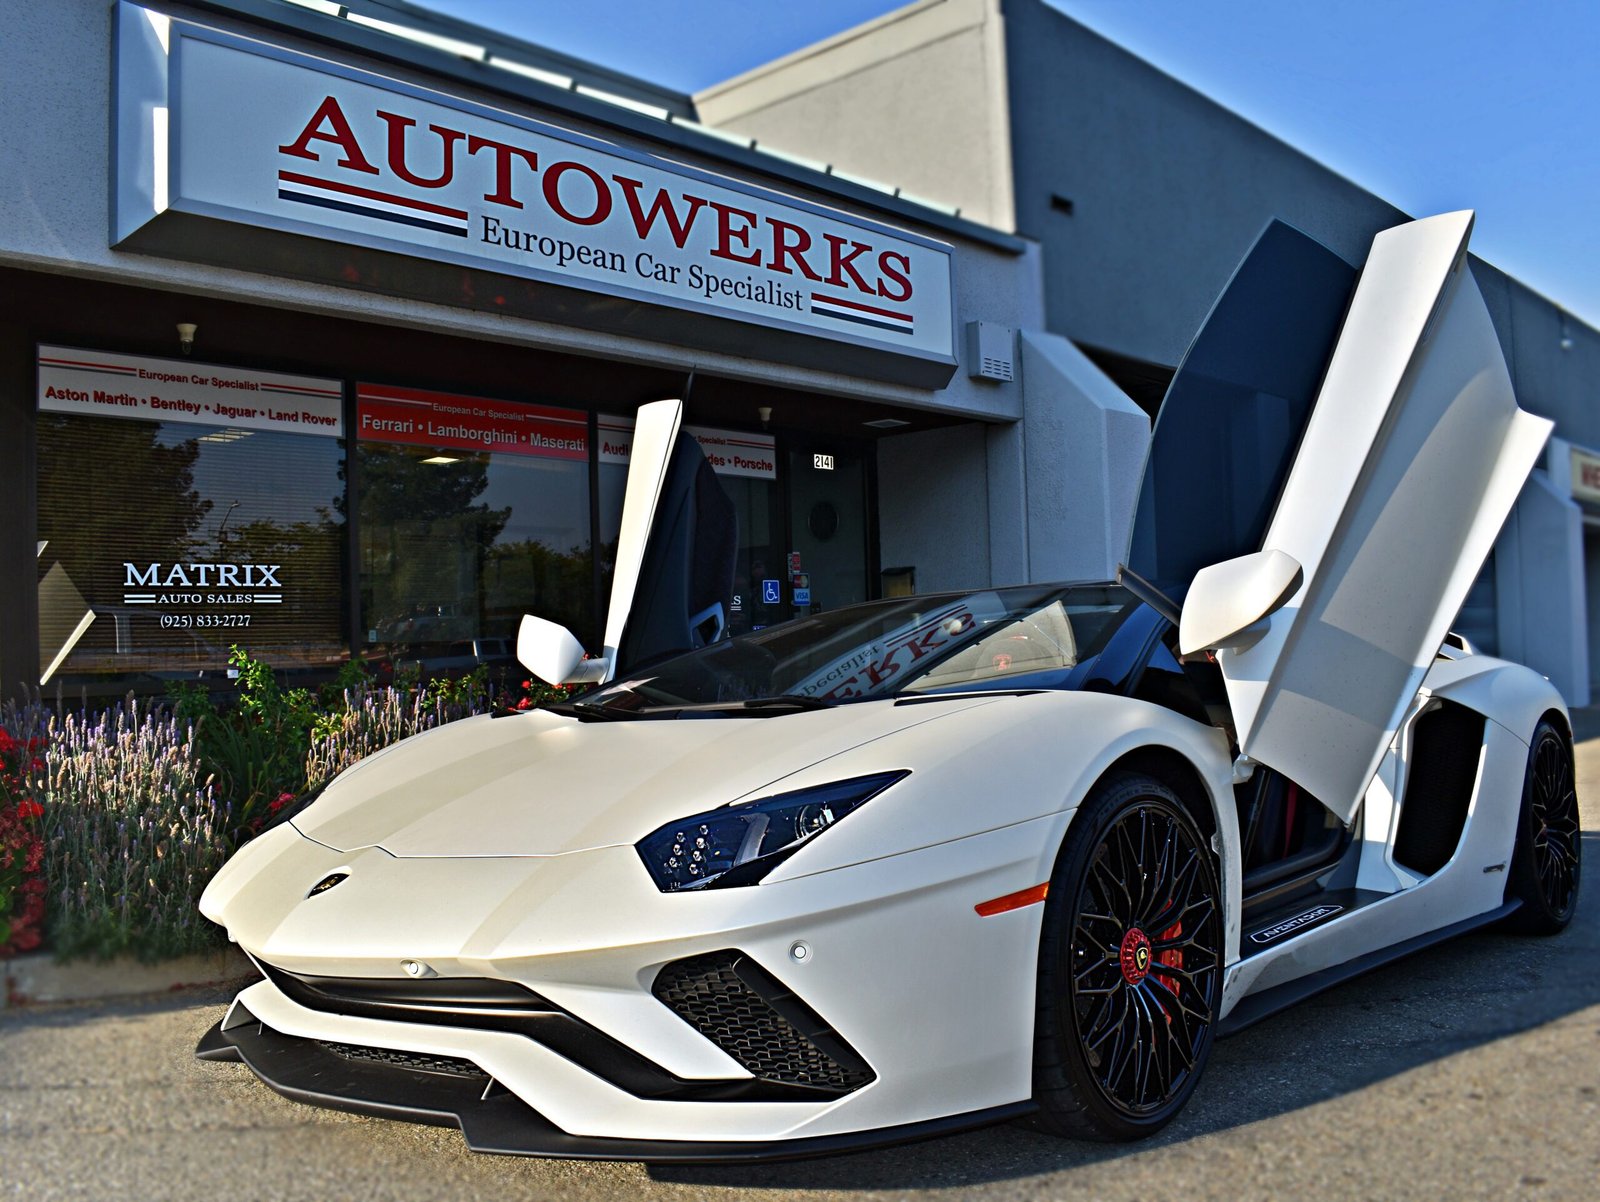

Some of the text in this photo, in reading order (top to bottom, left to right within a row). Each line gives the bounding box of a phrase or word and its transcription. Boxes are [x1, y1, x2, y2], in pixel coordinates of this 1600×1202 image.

[279, 96, 913, 302] AUTOWERKS
[481, 215, 803, 311] European Car Specialist
[138, 368, 260, 391] European Car Specialist
[44, 385, 337, 427] Aston Martin Bentley Jaguar Land Rover
[433, 402, 525, 422] European Car Specialist
[362, 414, 585, 452] Ferrari Lamborghini Maserati
[697, 435, 726, 445] Specialist
[602, 441, 629, 457] Audi
[733, 456, 773, 472] Porsche
[815, 455, 833, 469] 2141
[123, 562, 282, 587] MATRIX
[157, 593, 253, 604] AUTO SALES
[796, 591, 809, 600] VISA
[160, 614, 251, 629] (925) 833-2727
